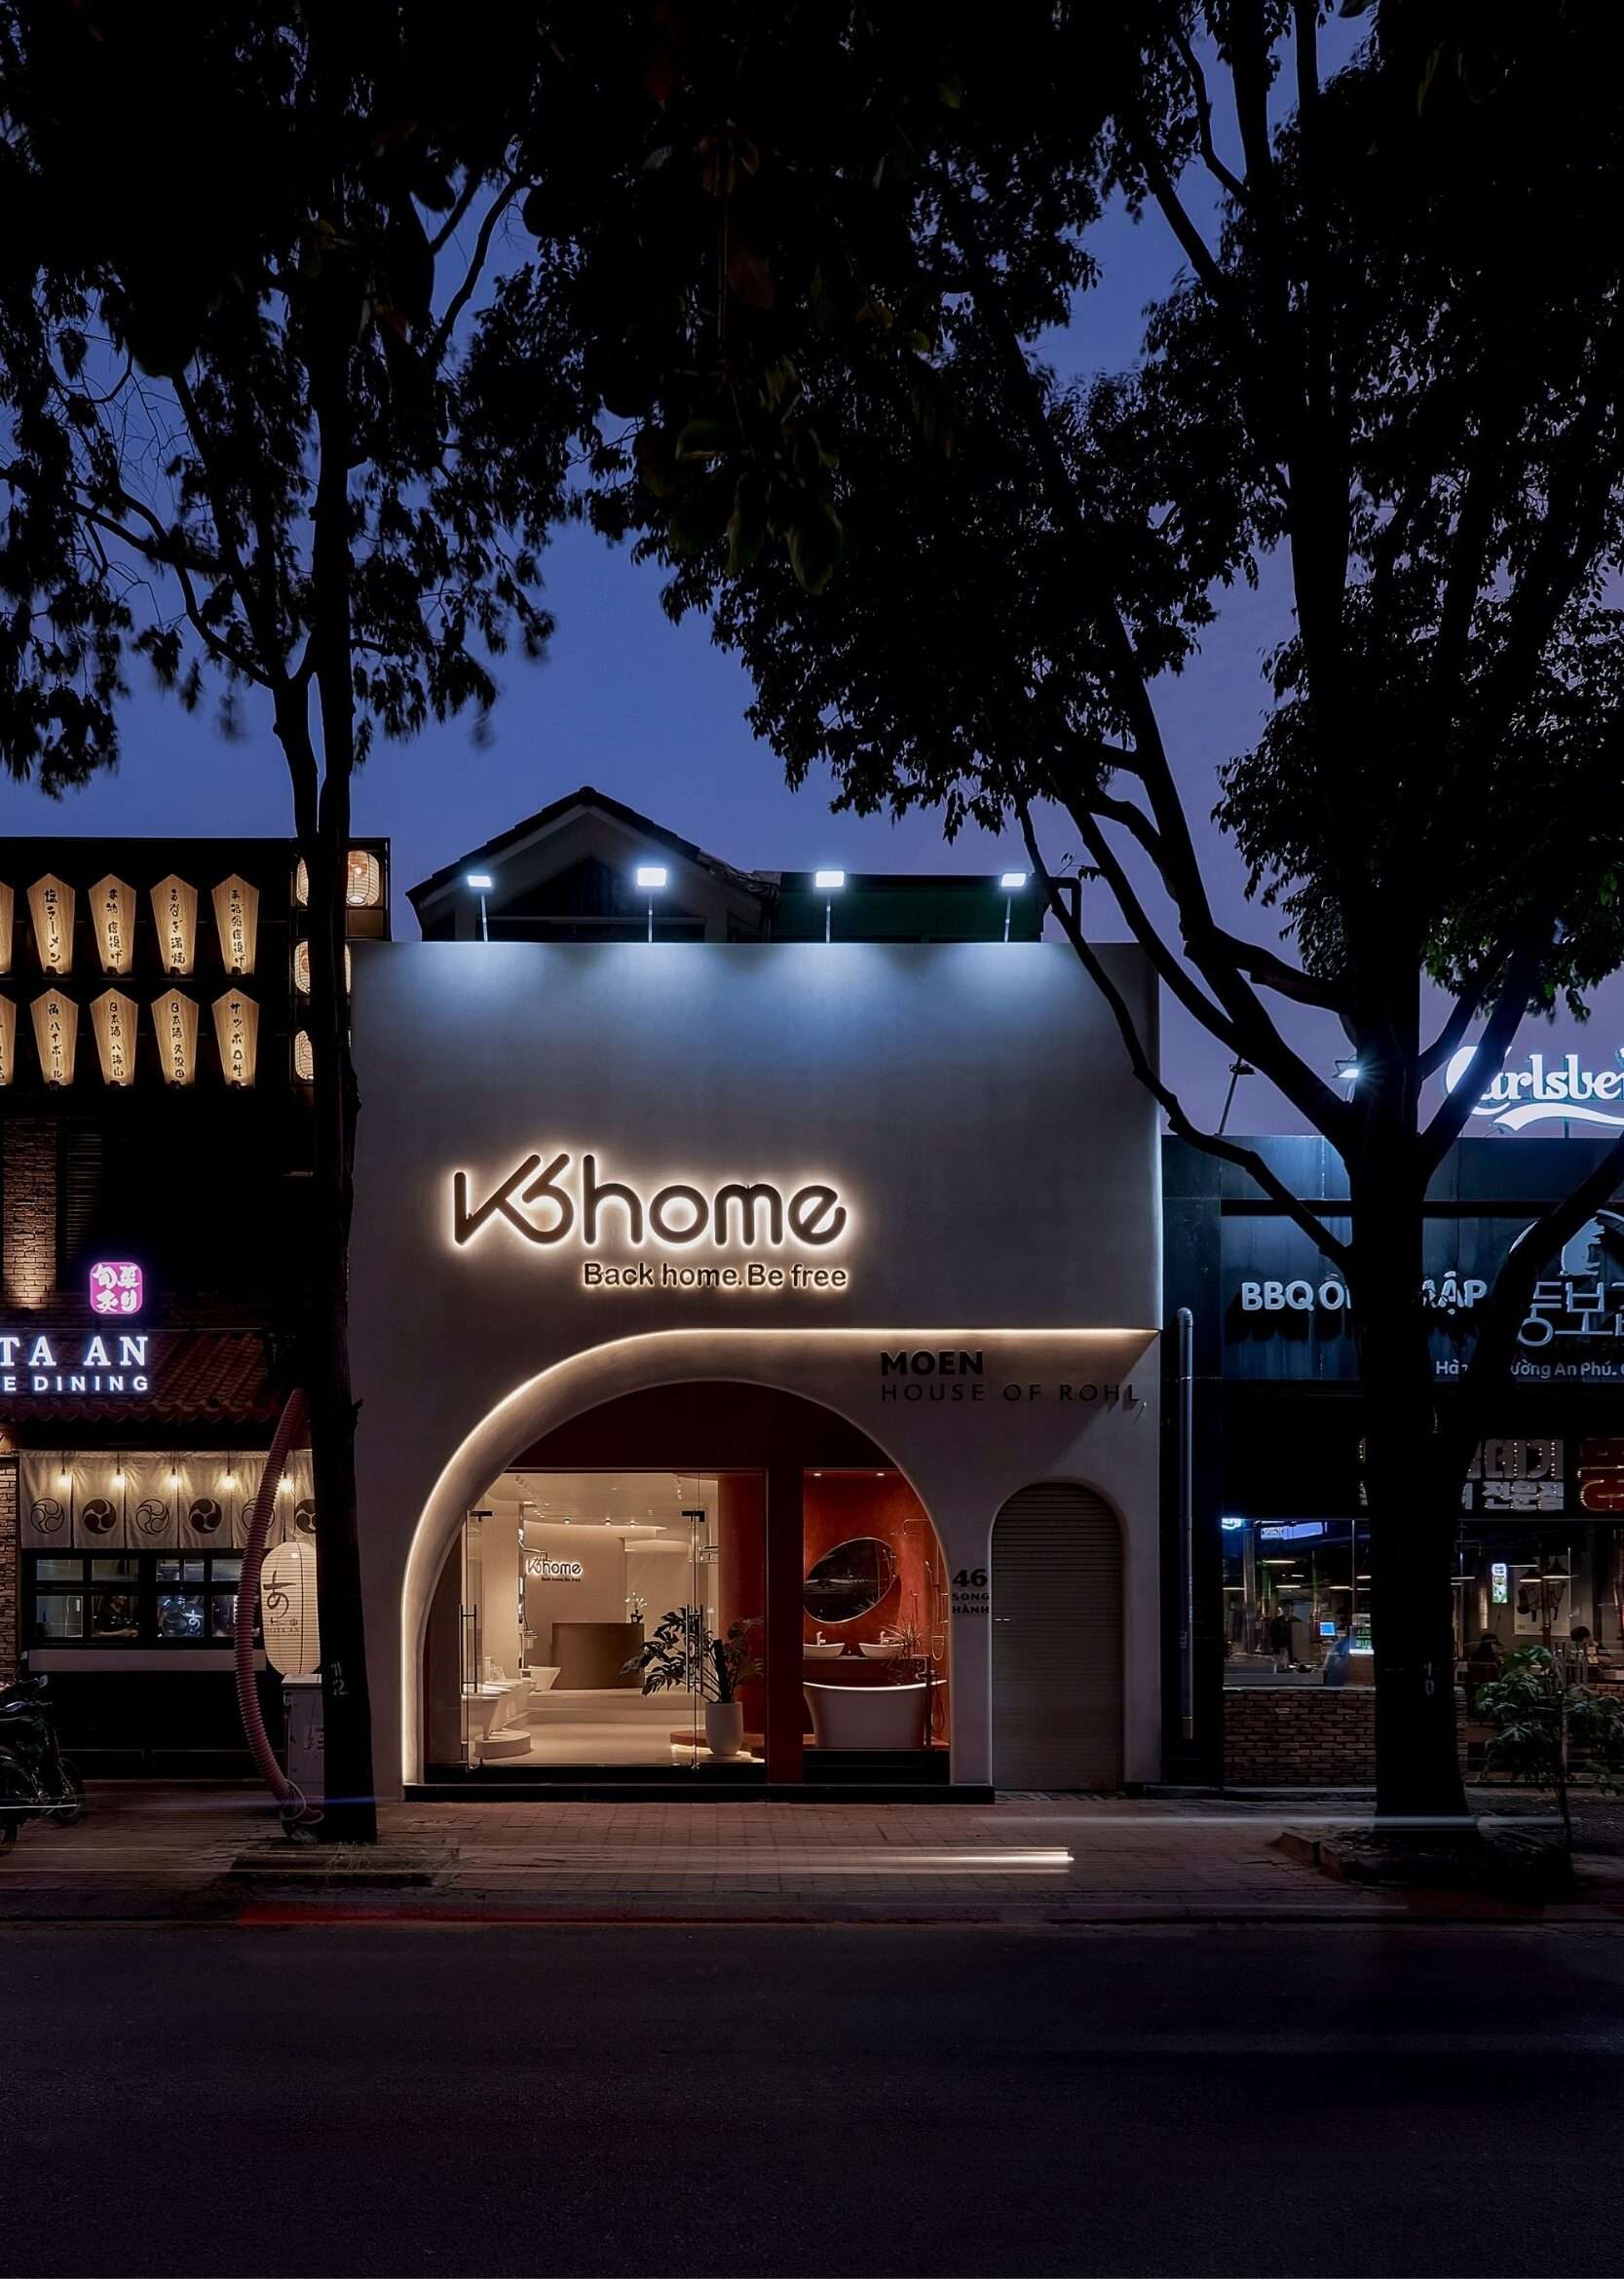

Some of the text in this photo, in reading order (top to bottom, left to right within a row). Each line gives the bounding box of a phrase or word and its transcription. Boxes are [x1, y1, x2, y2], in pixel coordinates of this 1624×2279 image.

[584, 1262, 654, 1287] Back
[792, 1263, 848, 1287] free
[1241, 1279, 1314, 1311] BBQ
[84, 1336, 149, 1366] AN
[880, 1350, 984, 1376] MOEN
[1554, 1361, 1576, 1377] An
[34, 1374, 148, 1392] DINING
[882, 1384, 1139, 1402] HOUSE OF ROHL
[952, 1569, 988, 1587] 46
[952, 1592, 990, 1601] SONG
